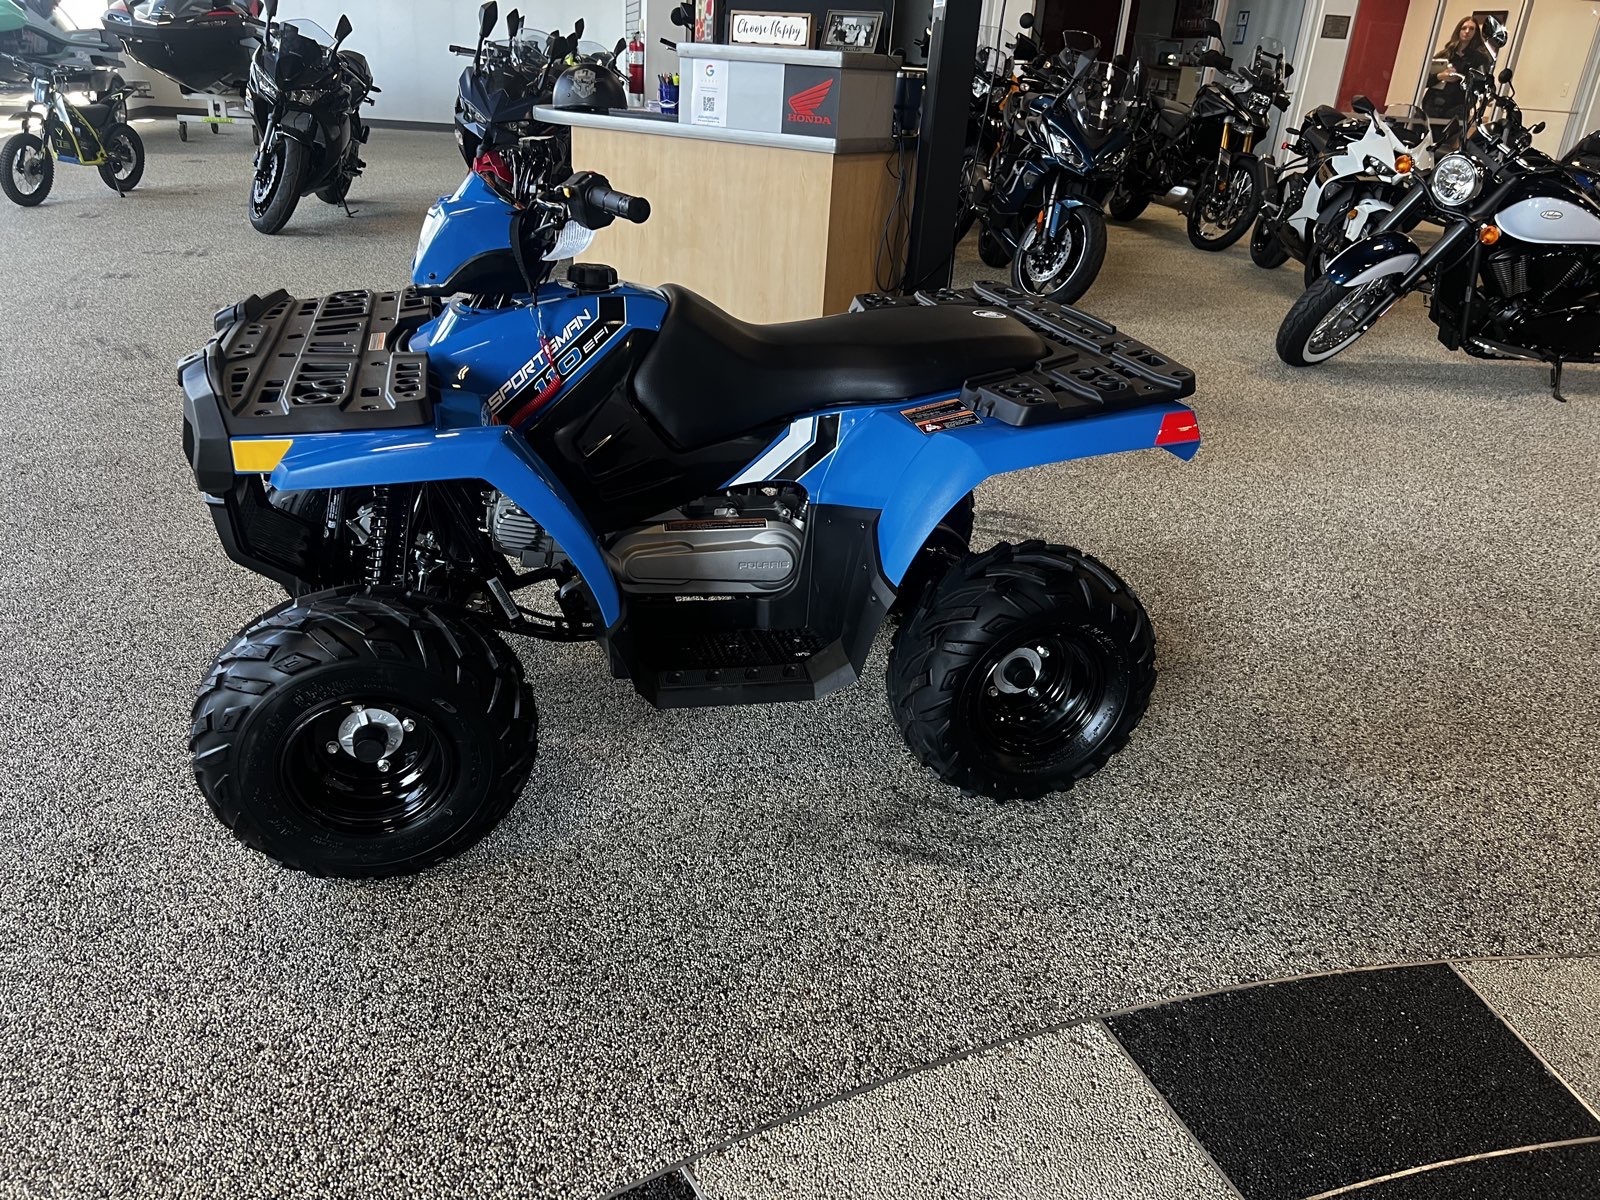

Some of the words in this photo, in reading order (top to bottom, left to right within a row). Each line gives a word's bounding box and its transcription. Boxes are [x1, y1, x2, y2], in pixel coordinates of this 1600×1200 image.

[737, 18, 768, 36] Choose
[769, 20, 802, 41] Happy
[788, 113, 832, 125] HONDA
[583, 325, 609, 354] EFI
[487, 308, 592, 411] SPORTSMAN
[738, 560, 790, 570] POLARIS
